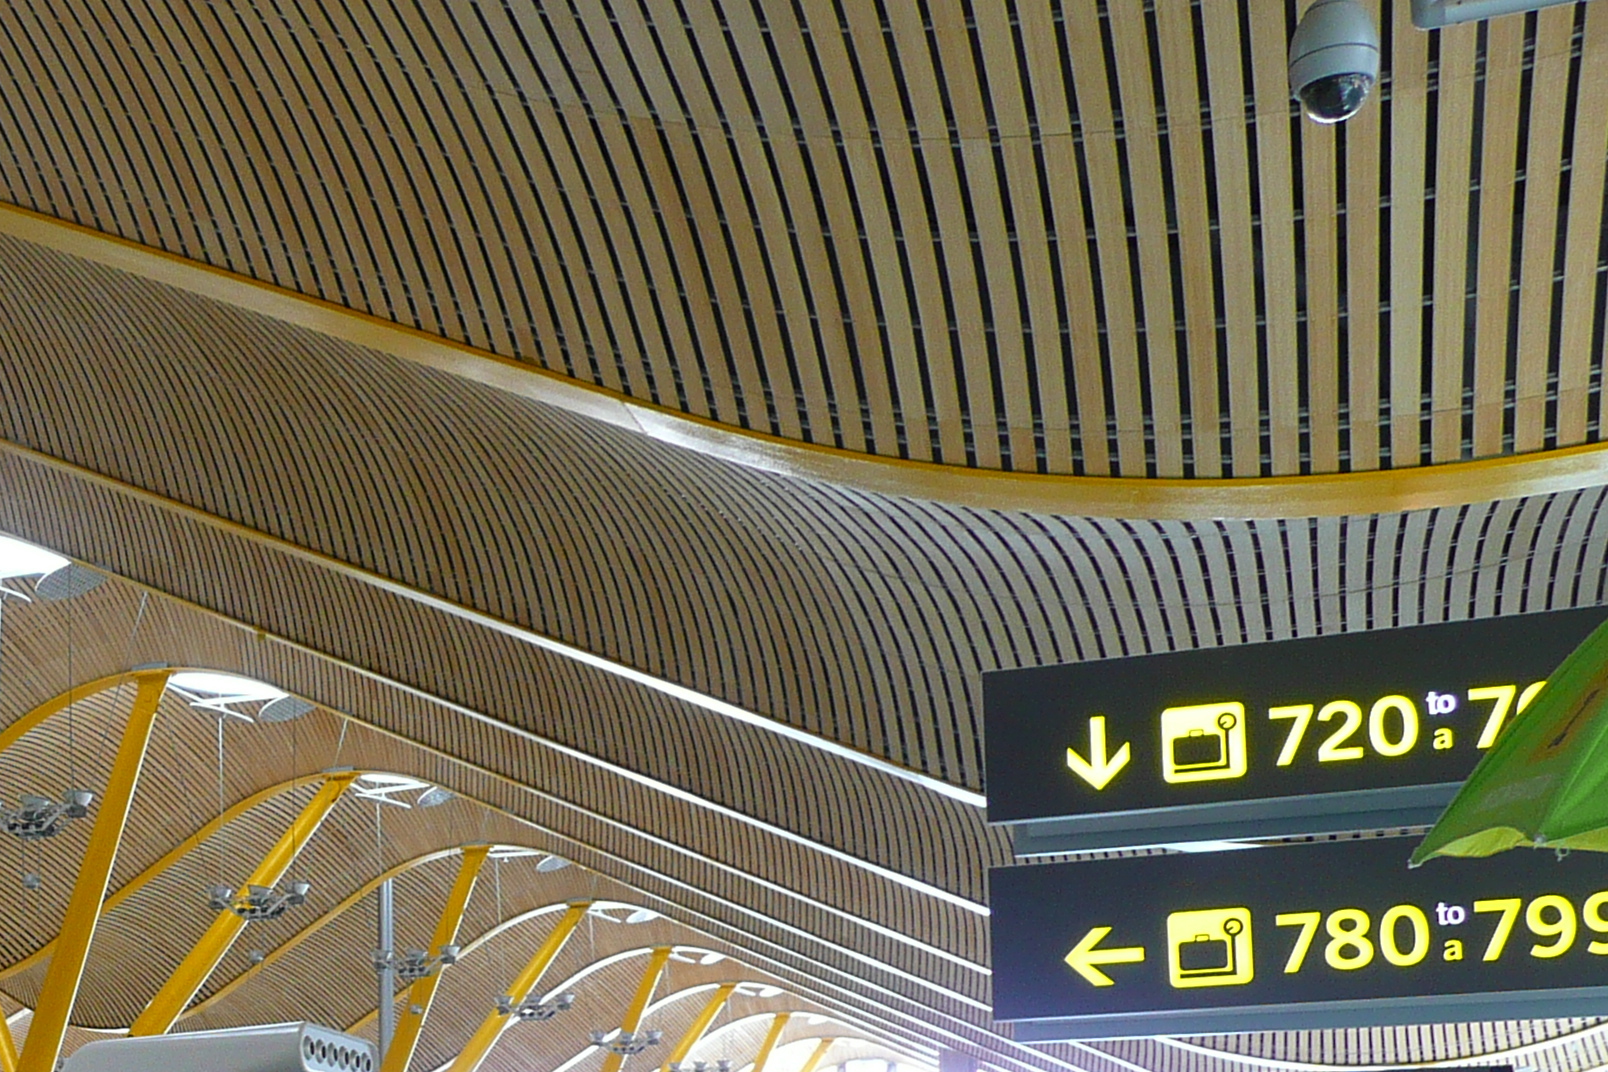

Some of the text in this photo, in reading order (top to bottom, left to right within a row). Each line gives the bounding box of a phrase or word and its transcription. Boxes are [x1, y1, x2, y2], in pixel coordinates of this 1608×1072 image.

[1425, 690, 1457, 716] to
[1268, 694, 1419, 767] 720
[1432, 727, 1454, 750] a
[1435, 901, 1466, 926] to
[1275, 903, 1431, 974] 780
[1442, 938, 1464, 961] a
